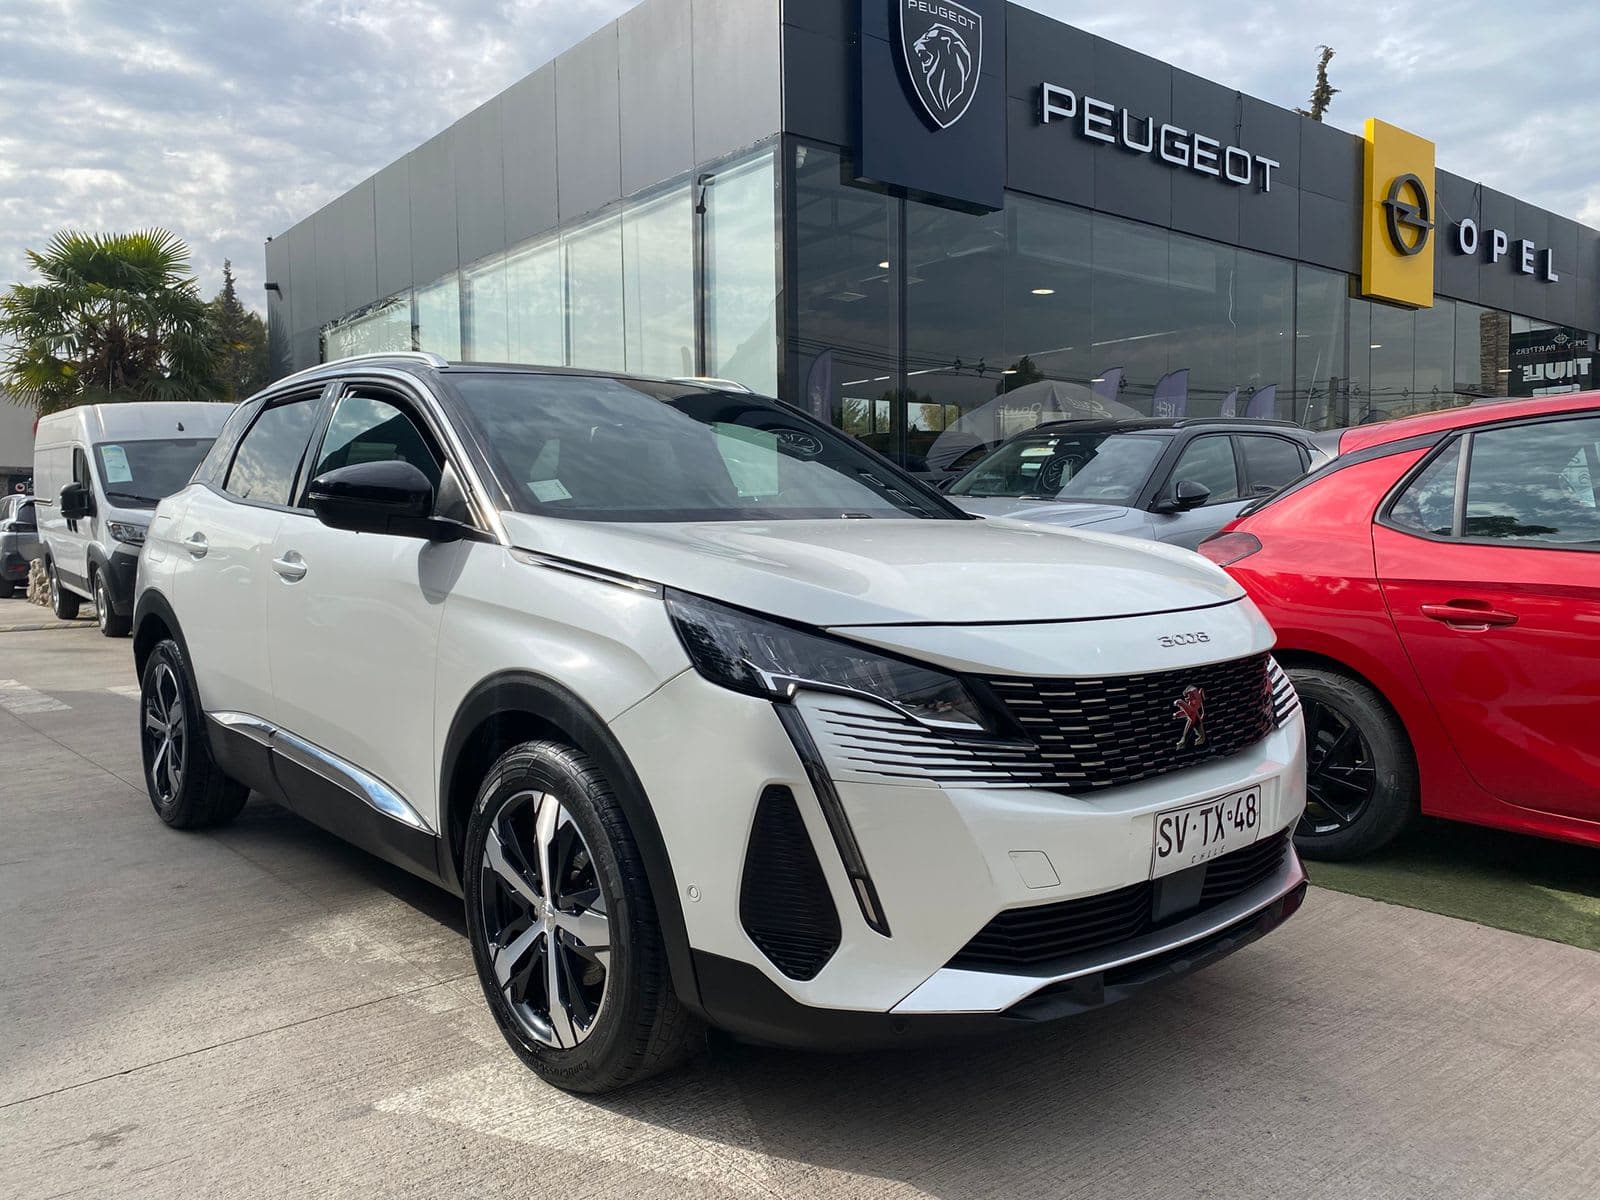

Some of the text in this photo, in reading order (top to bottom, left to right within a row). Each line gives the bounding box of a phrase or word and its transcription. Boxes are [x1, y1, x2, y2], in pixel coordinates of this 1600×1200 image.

[908, 0, 976, 30] PEUGEOT
[1041, 82, 1280, 192] PEUGEOT
[1459, 218, 1559, 283] OPEL
